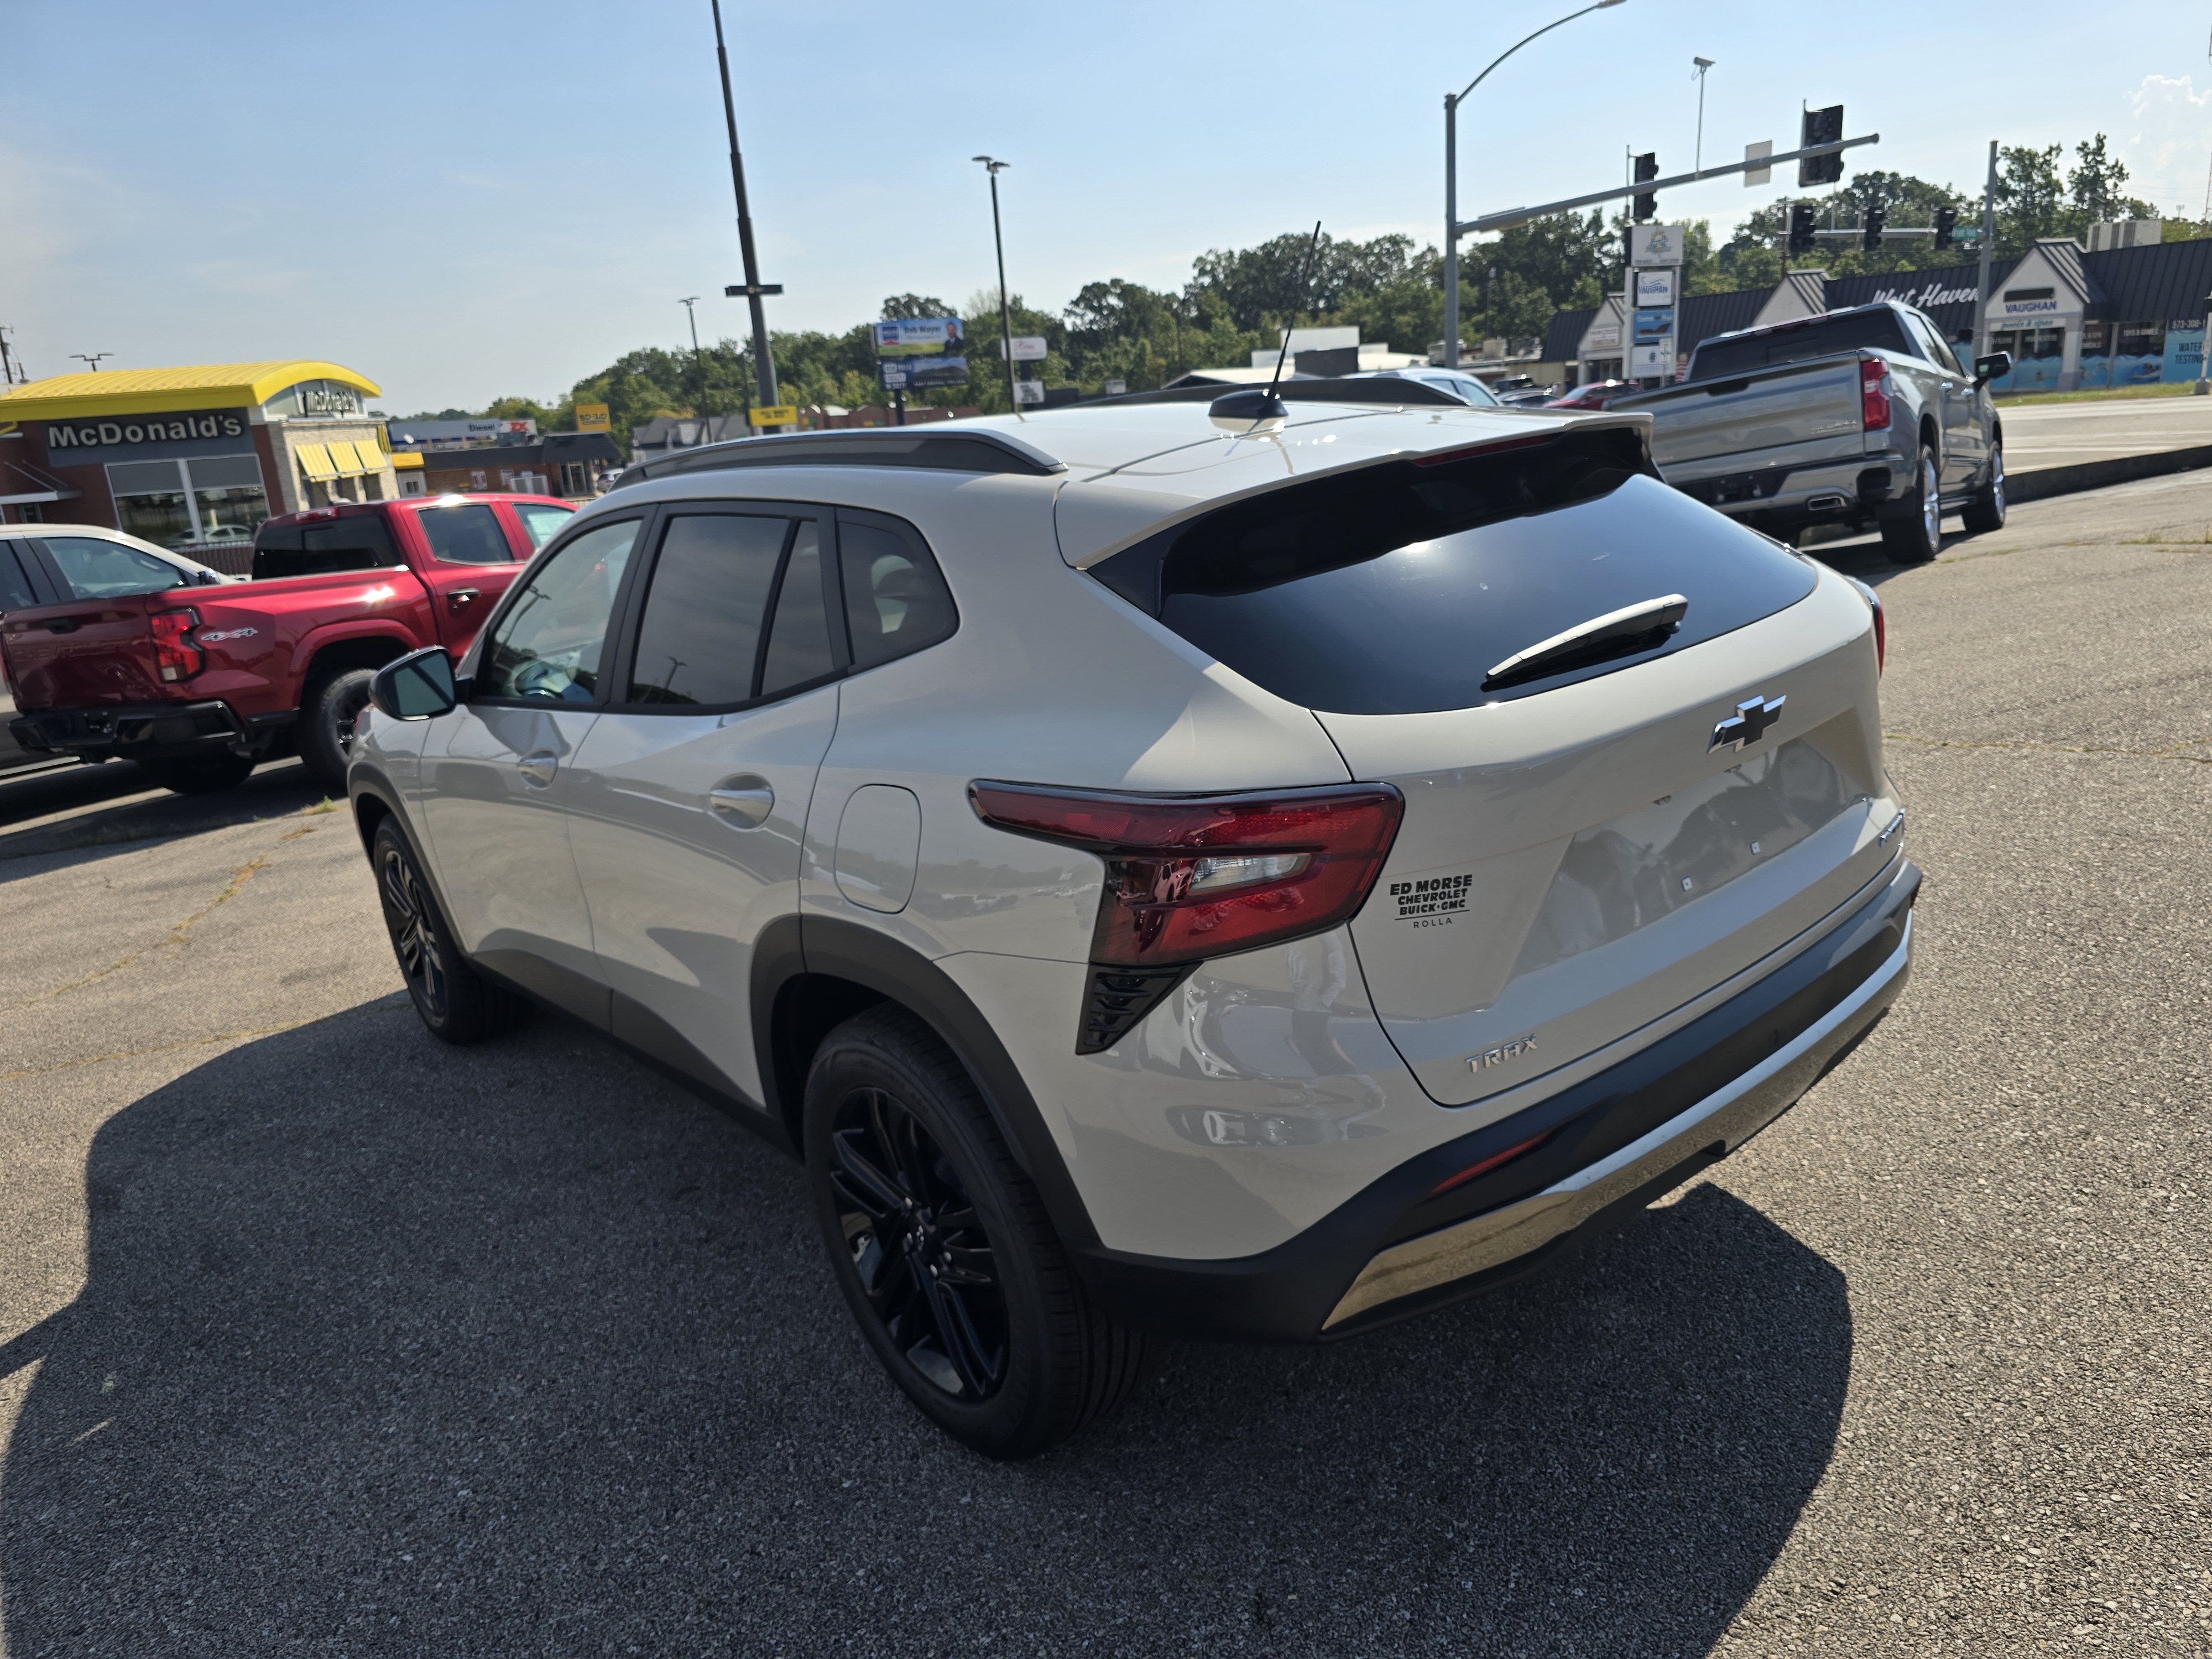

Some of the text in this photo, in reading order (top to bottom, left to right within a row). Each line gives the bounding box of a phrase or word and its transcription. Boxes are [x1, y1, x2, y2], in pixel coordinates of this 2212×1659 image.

[1871, 283, 1980, 308] Wst Haven
[2005, 301, 2057, 313] VAUGHAN
[2175, 354, 2204, 364] TESTING
[49, 415, 242, 448] McDonald's
[468, 423, 495, 432] Diesel
[1390, 874, 1472, 895] ED MORSE
[1398, 888, 1468, 905] CHEVROLET
[1413, 917, 1452, 928] ROLLA
[1465, 1033, 1537, 1073] TRAX
